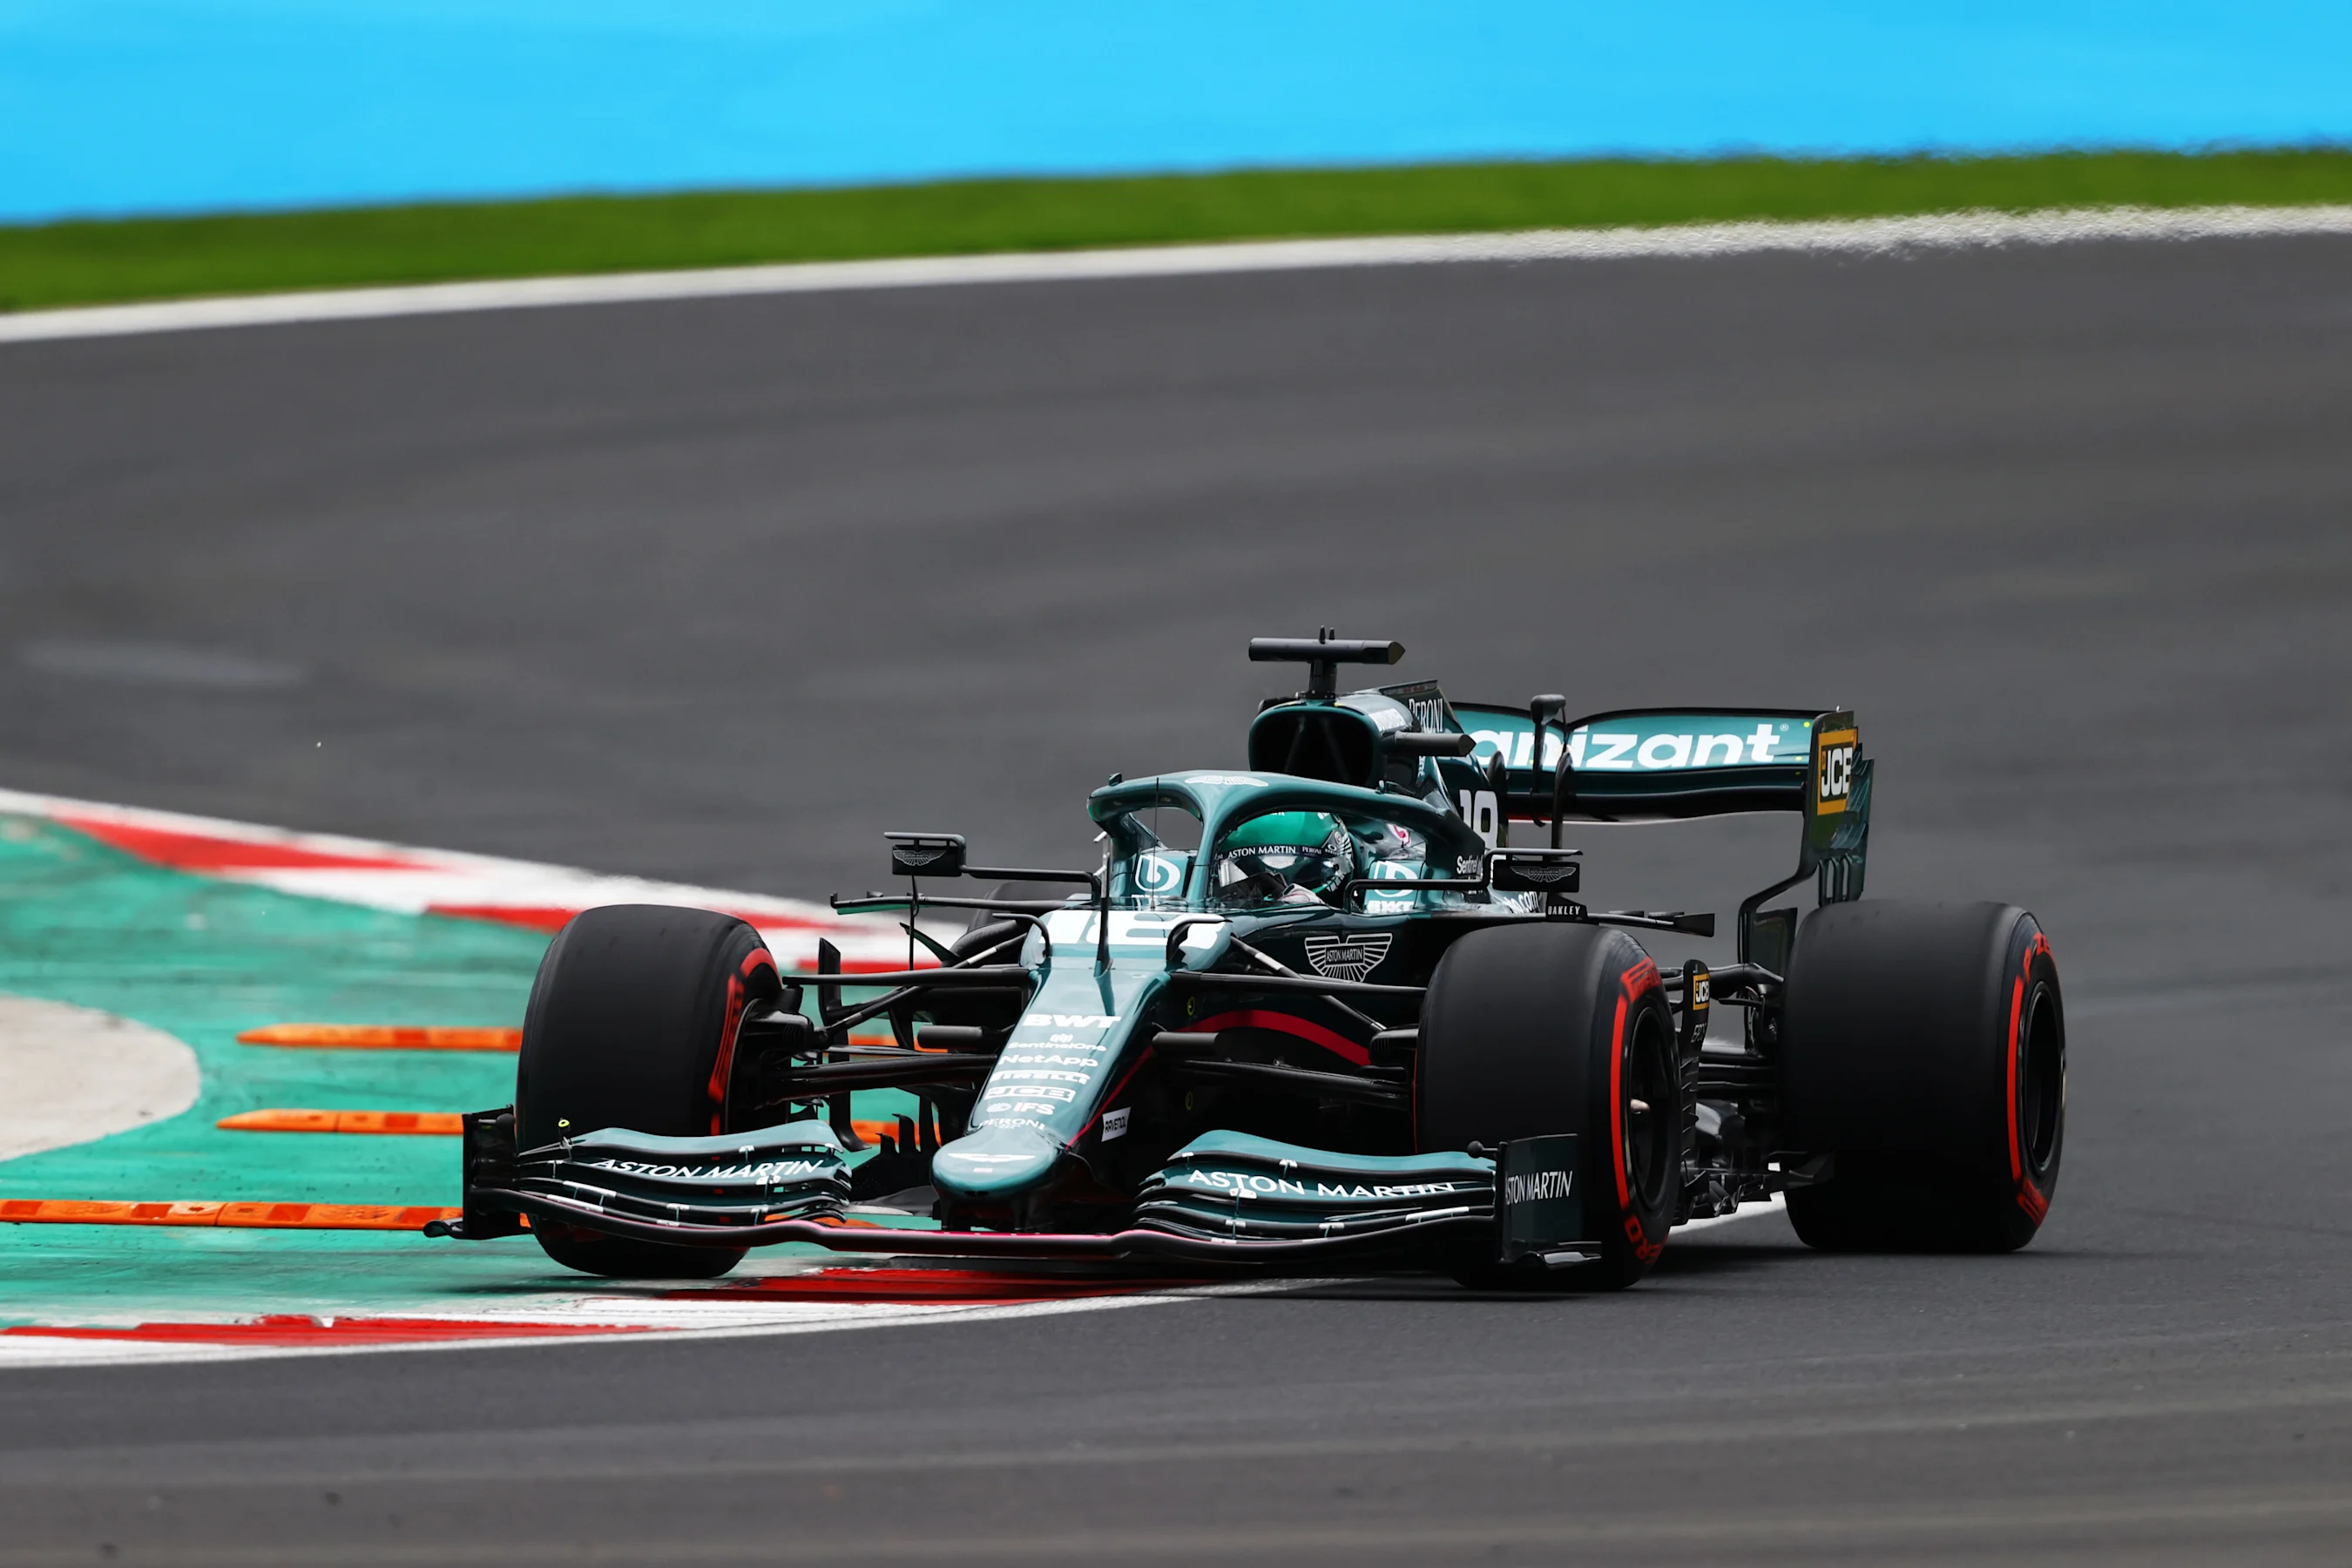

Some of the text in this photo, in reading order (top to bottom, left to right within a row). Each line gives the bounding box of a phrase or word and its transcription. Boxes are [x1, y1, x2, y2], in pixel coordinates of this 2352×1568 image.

[1408, 698, 1443, 733] PERONI
[1227, 847, 1256, 860] ASTON
[1258, 845, 1296, 855] MARTIN
[1548, 905, 1581, 916] OAKLEY
[1326, 949, 1363, 963] ASTON MARTIN
[1023, 1014, 1122, 1028] BWT
[1007, 1042, 1106, 1052] SentinelOne
[998, 1054, 1098, 1067] NetApp
[989, 1070, 1091, 1085] PIRELLI
[989, 1086, 1072, 1101] JCB
[1013, 1102, 1056, 1115] IFS
[978, 1118, 1044, 1130] PERONI
[591, 1159, 824, 1179] ASTON MARTIN
[1188, 1169, 1456, 1198] ASTON MARTIN
[1526, 1170, 1573, 1200] MARTIN
